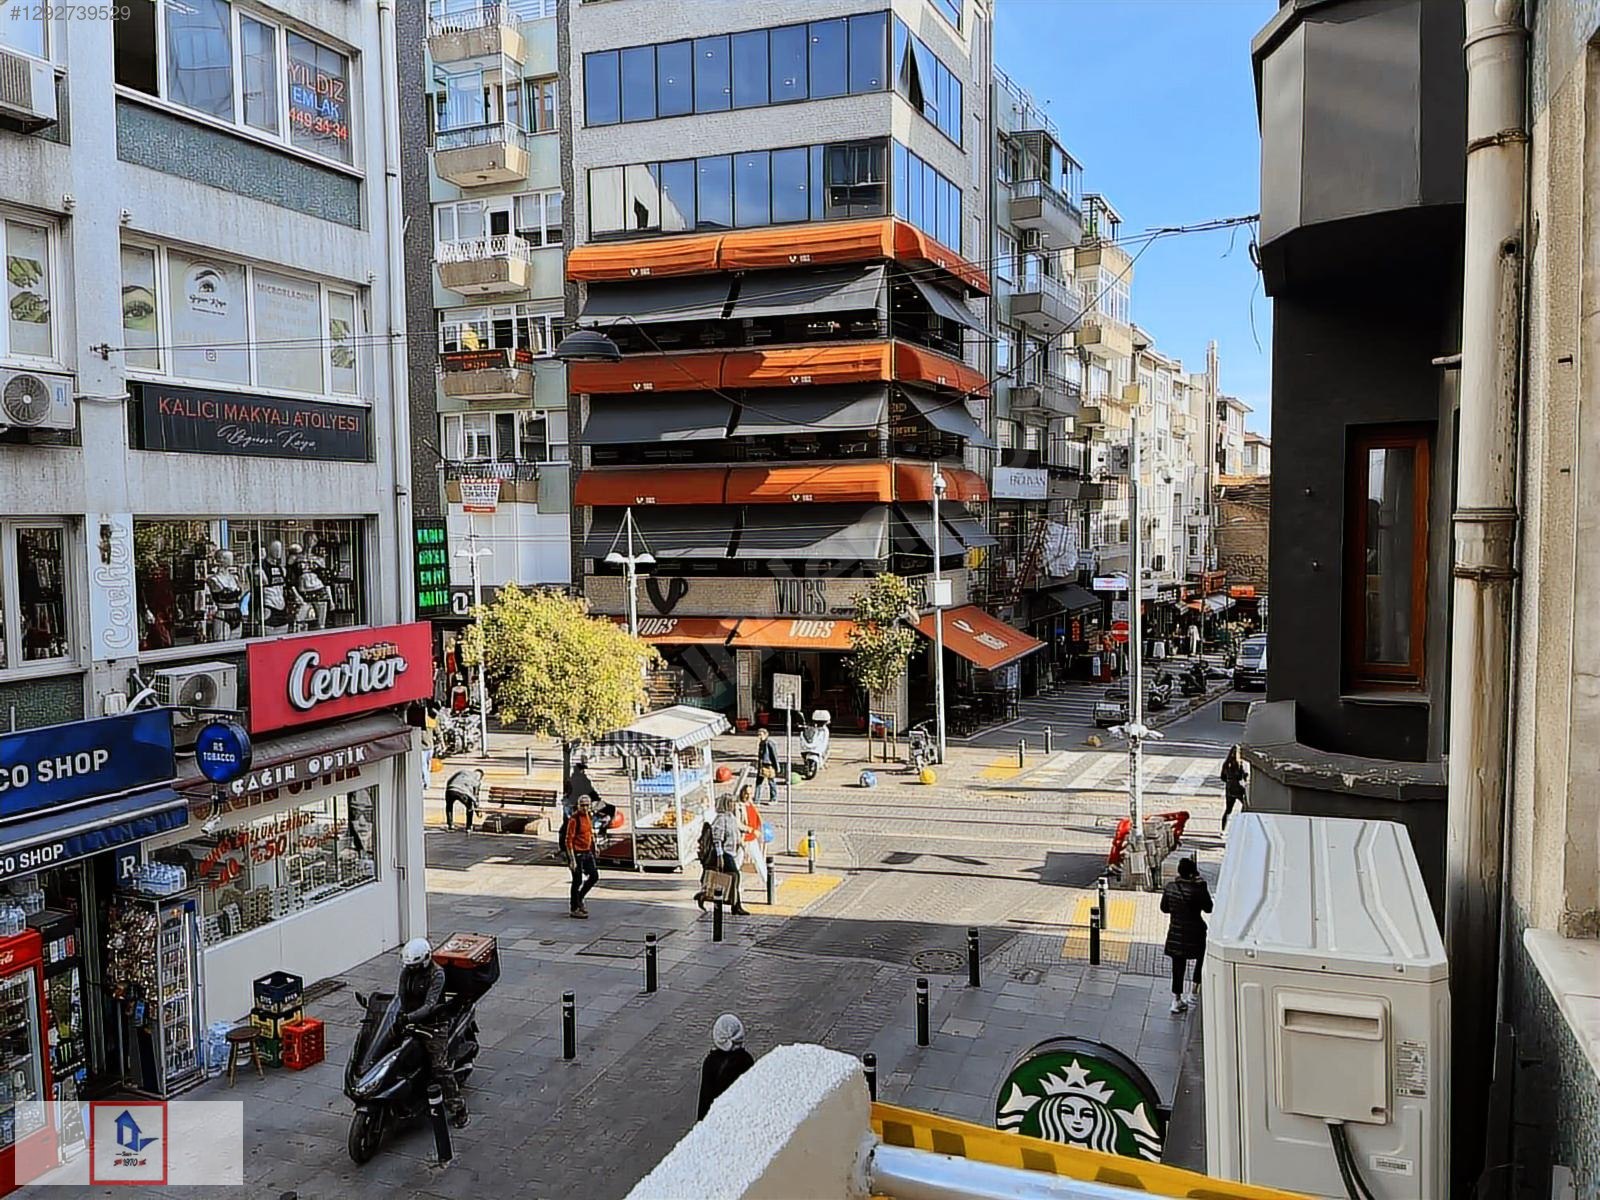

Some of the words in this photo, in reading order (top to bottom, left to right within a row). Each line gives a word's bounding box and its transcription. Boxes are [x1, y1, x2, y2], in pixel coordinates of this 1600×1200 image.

[290, 65, 345, 103] YILDIZ
[293, 86, 340, 120] EMLAK
[159, 396, 219, 419] KALICI
[224, 404, 289, 425] MAKYAJ
[774, 578, 827, 615] VOGS
[637, 617, 678, 636] VOGS
[788, 619, 835, 638] VOGS
[288, 650, 408, 710] Cevher
[37, 749, 109, 783] SHOP
[203, 751, 236, 763] TOBACCO
[308, 746, 366, 775] OPTİK
[19, 843, 65, 868] SHOP
[249, 835, 287, 863] %50
